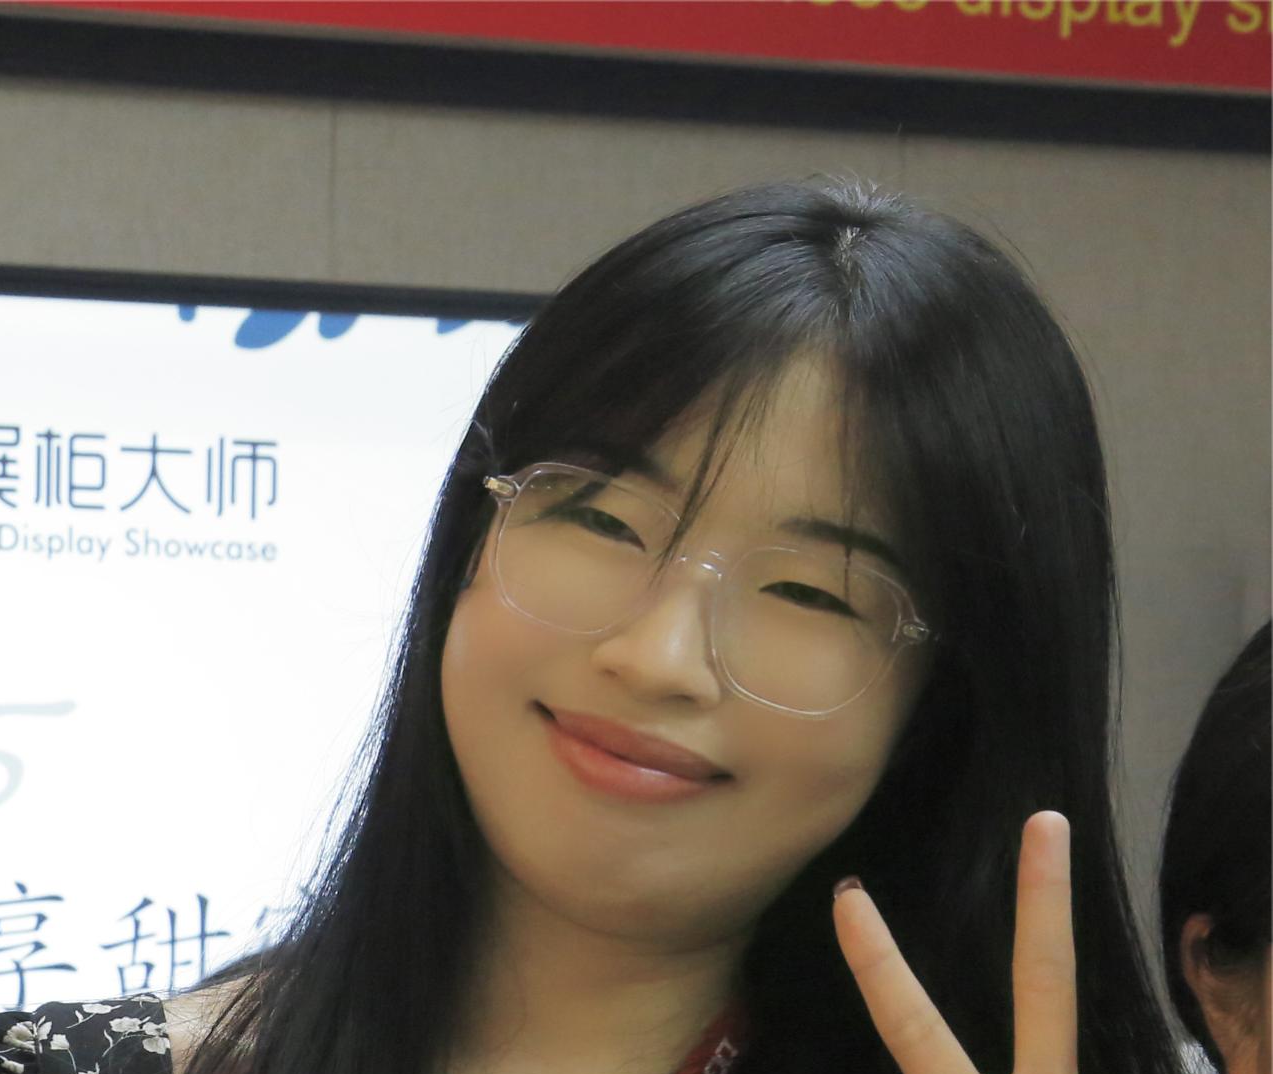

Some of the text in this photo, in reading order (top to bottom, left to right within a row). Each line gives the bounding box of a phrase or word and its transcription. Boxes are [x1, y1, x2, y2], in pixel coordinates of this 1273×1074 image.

[956, 0, 1272, 47] spay s
[124, 527, 279, 562] Showcase
